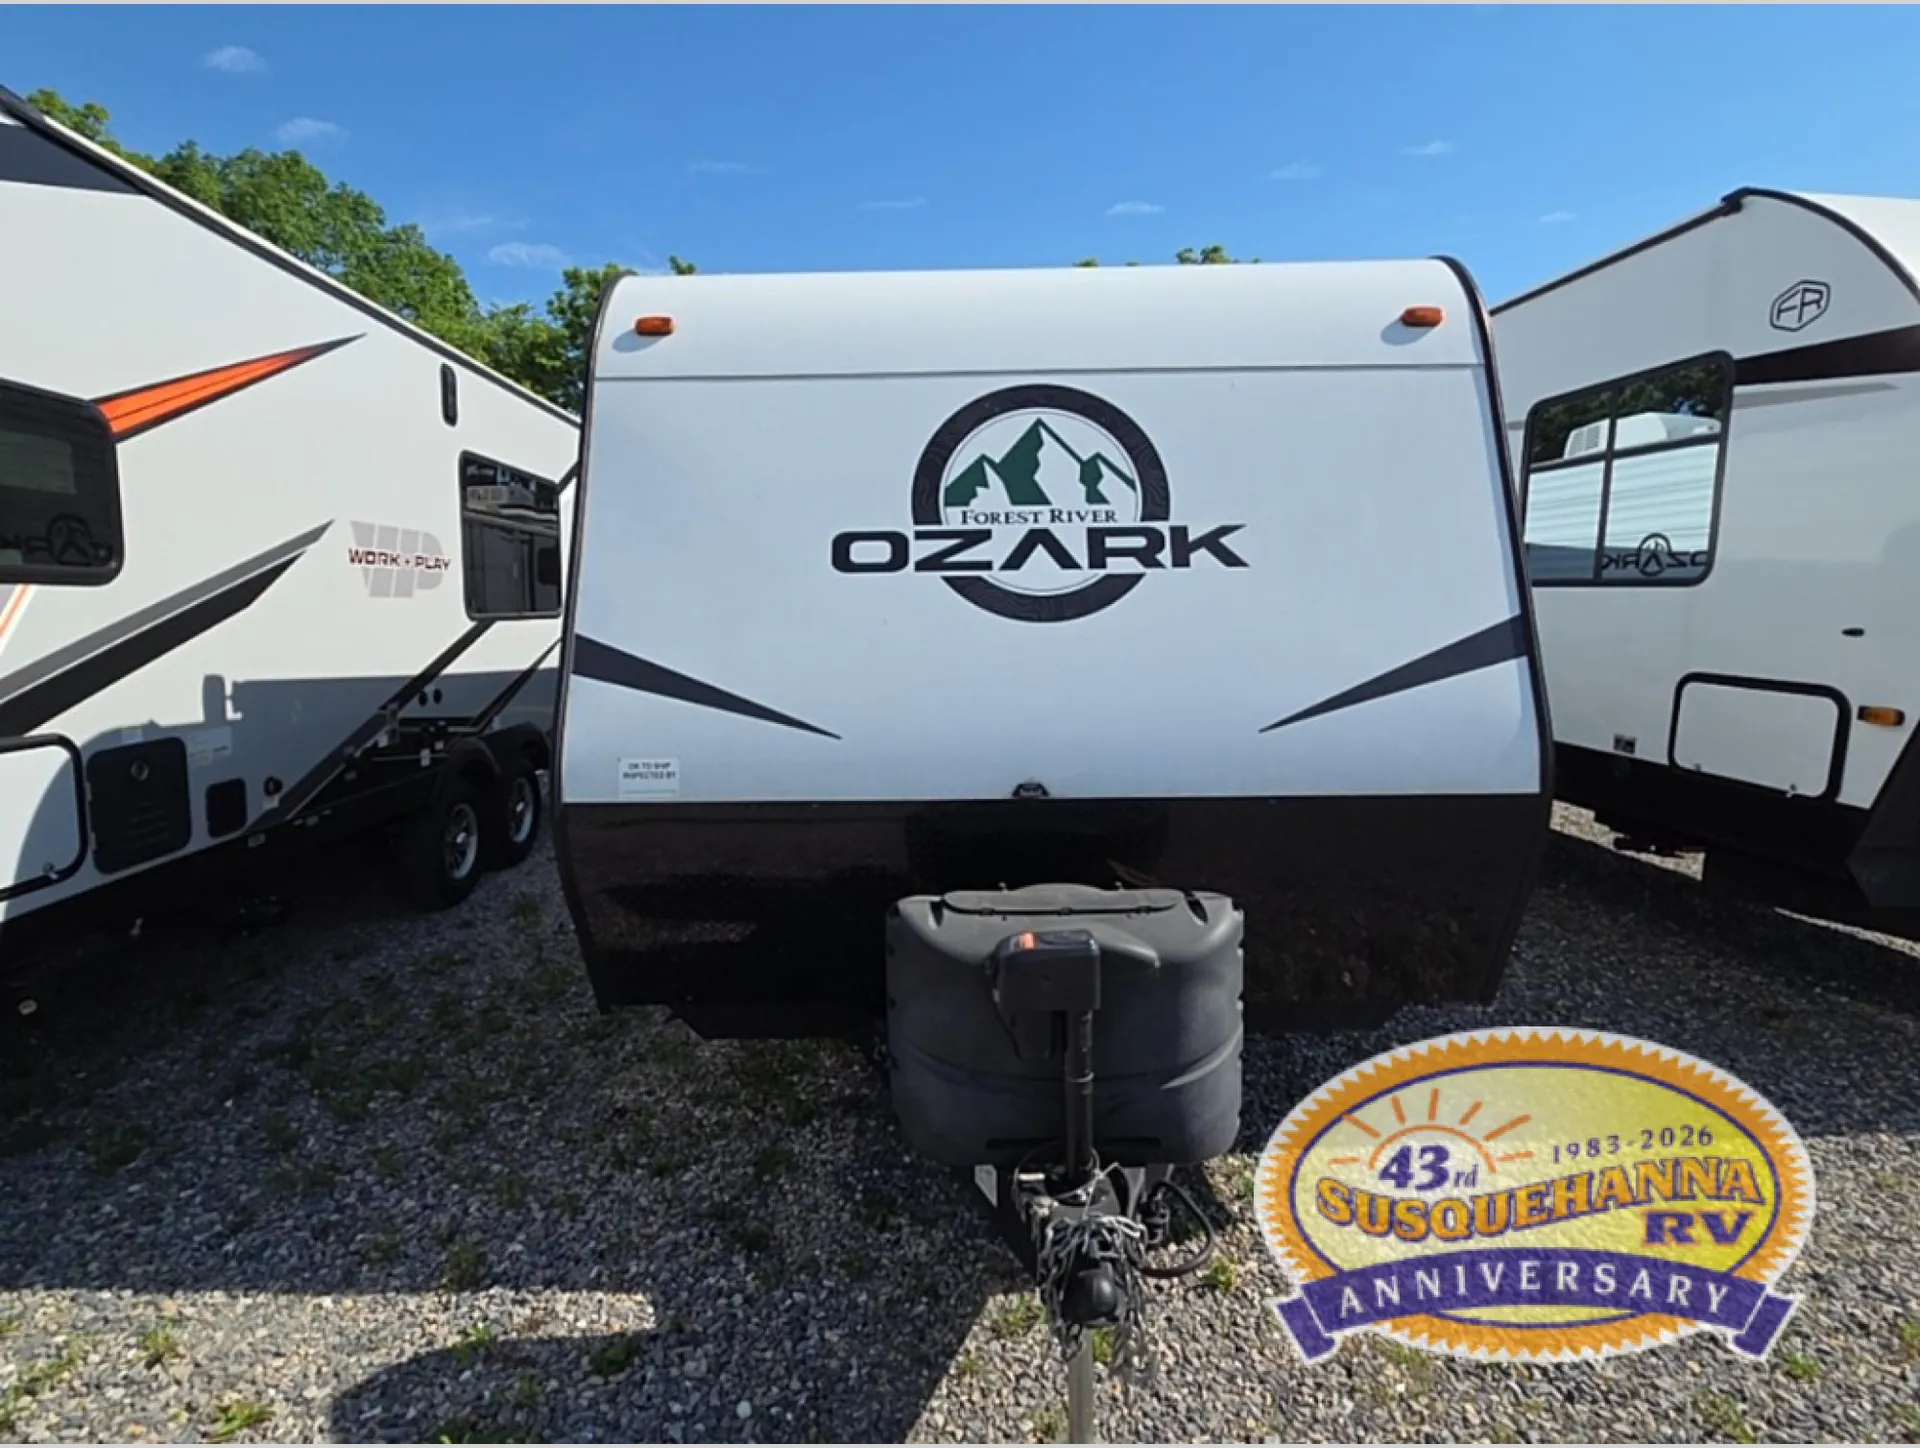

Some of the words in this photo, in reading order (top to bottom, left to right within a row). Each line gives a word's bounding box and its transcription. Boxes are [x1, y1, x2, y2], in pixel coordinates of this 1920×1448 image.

[1776, 288, 1823, 323] FR
[960, 508, 1042, 525] FOREST
[1049, 507, 1118, 524] RIVER
[348, 548, 400, 567] WORK
[414, 554, 451, 571] PLAY
[831, 523, 1249, 573] OZARK
